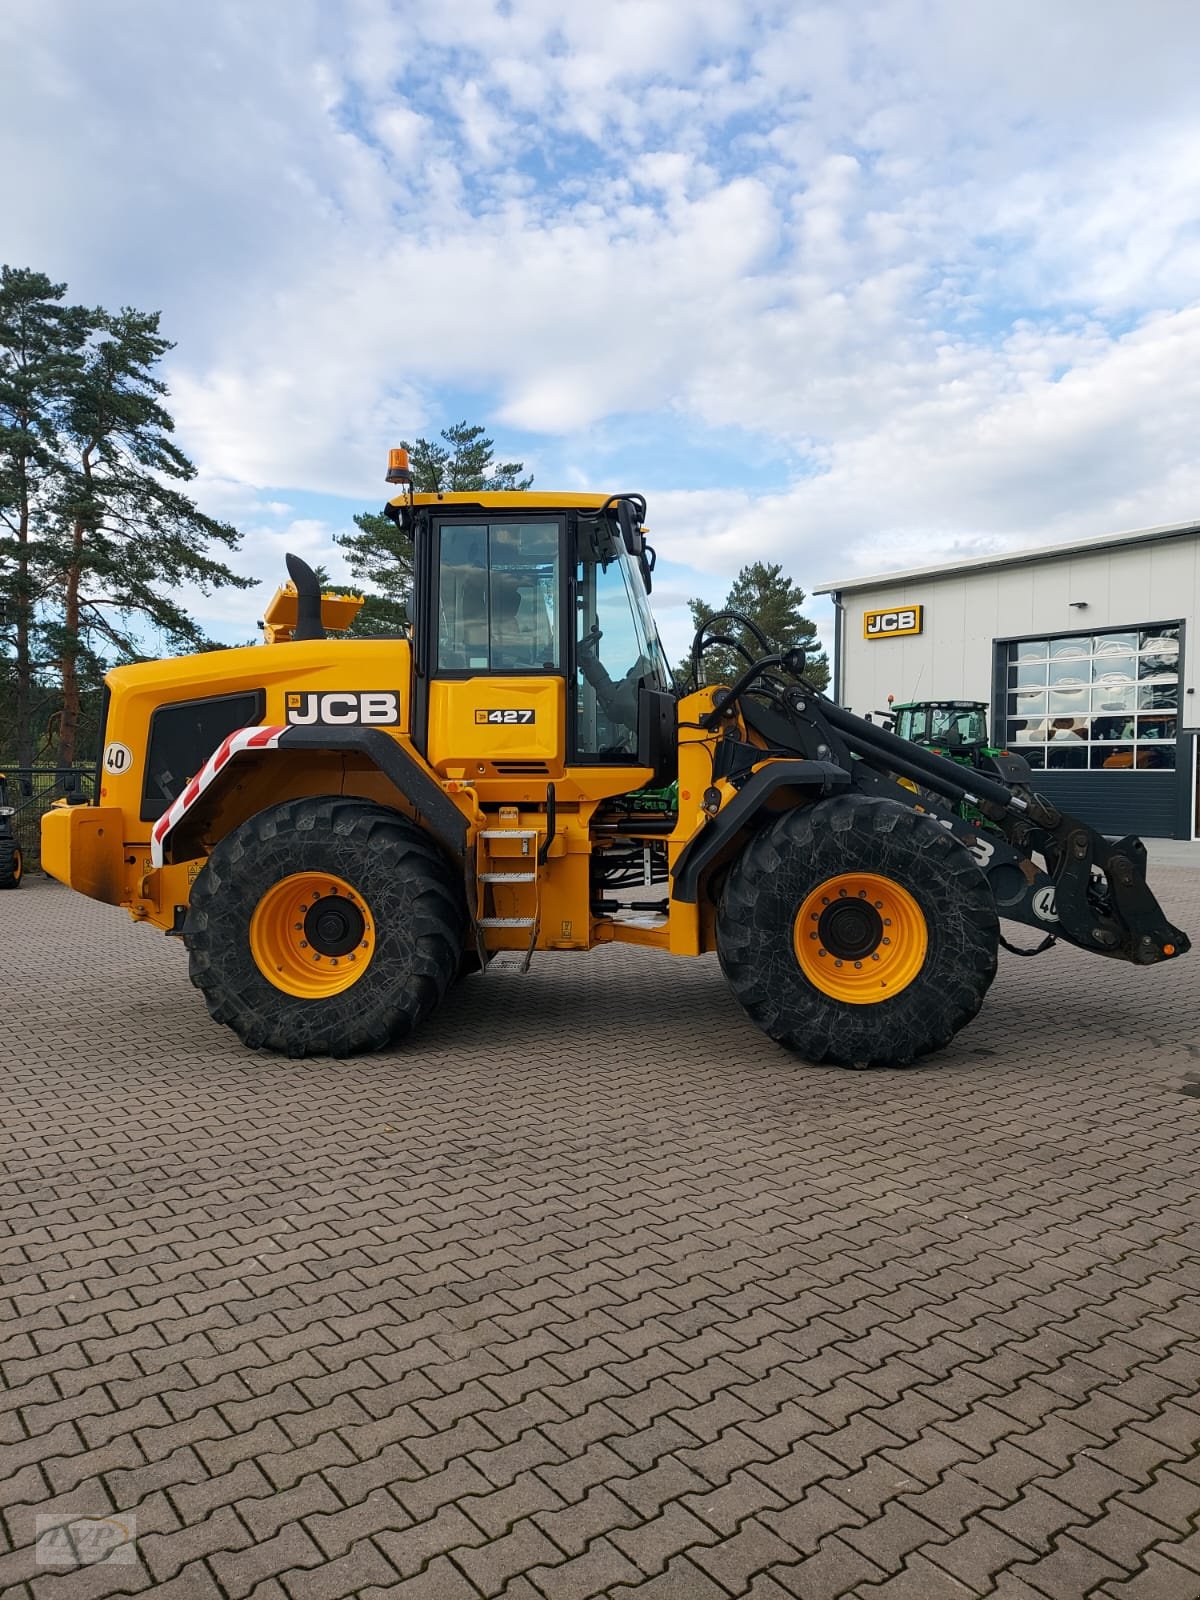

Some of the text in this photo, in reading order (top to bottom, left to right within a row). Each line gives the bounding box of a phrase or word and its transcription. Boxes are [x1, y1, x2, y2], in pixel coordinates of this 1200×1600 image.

[868, 611, 915, 633] JCB
[288, 693, 397, 725] JCB
[488, 710, 532, 723] 427
[107, 748, 125, 769] 40
